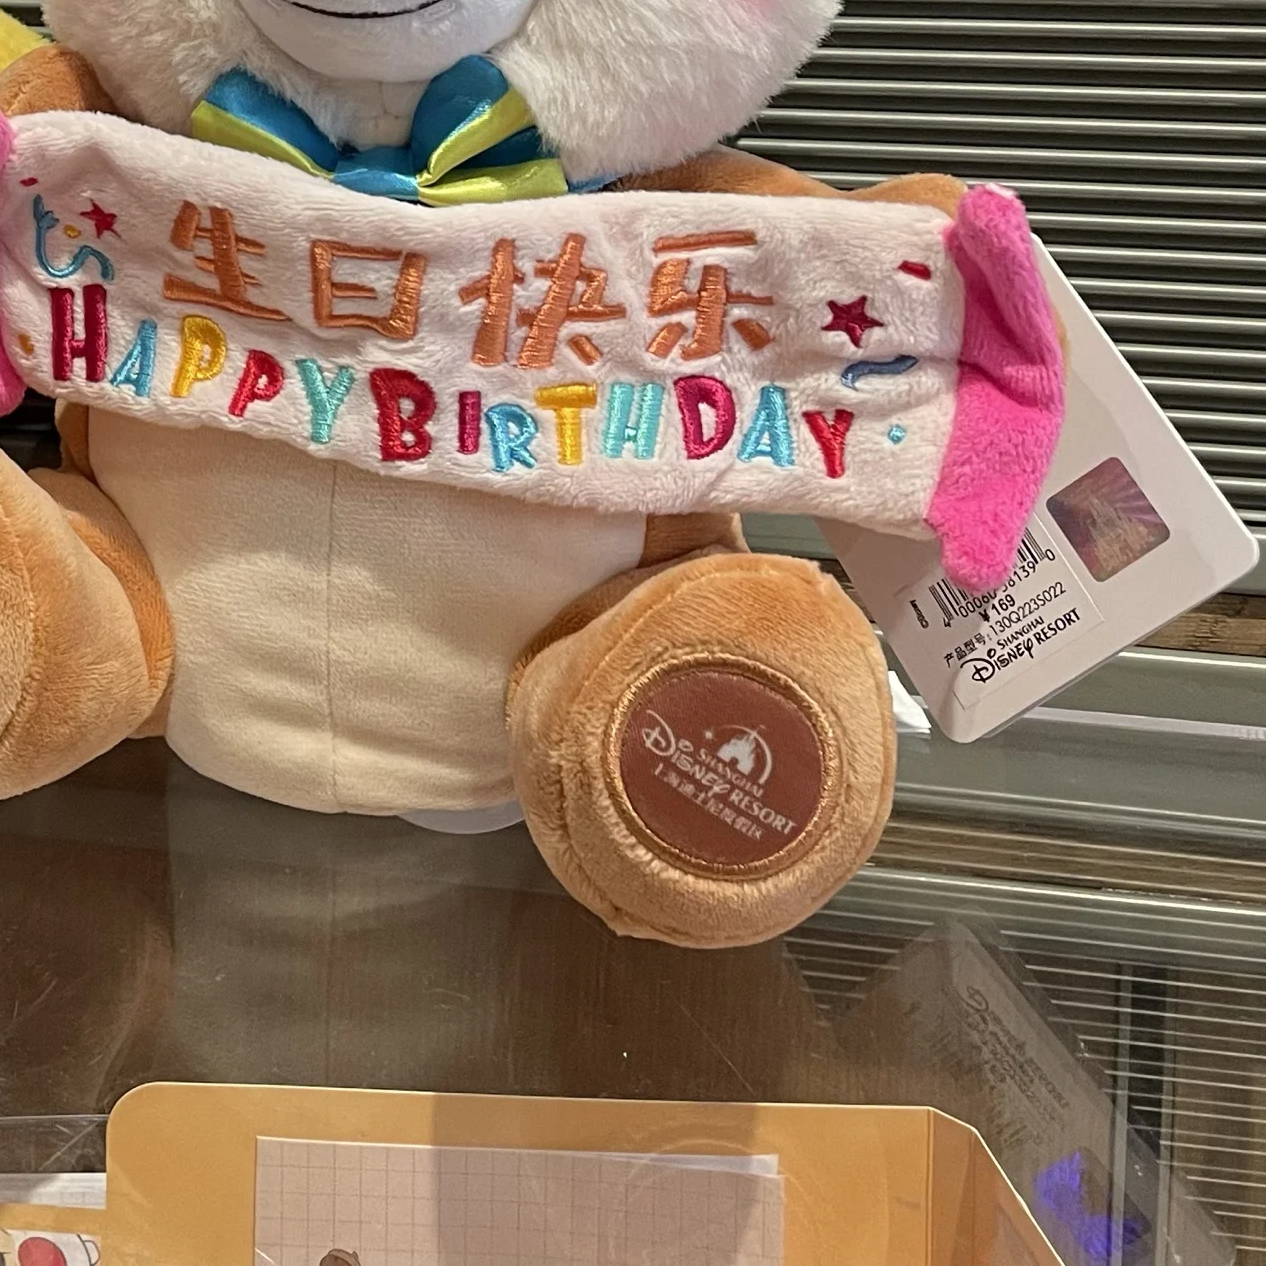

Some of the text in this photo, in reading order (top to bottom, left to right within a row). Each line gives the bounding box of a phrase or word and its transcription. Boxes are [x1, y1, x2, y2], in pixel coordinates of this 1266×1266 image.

[163, 200, 774, 370] 生日快乐
[49, 284, 855, 479] HAPPY BIRTHDAY
[1033, 607, 1081, 646] RESORT
[728, 791, 798, 835] RESORT
